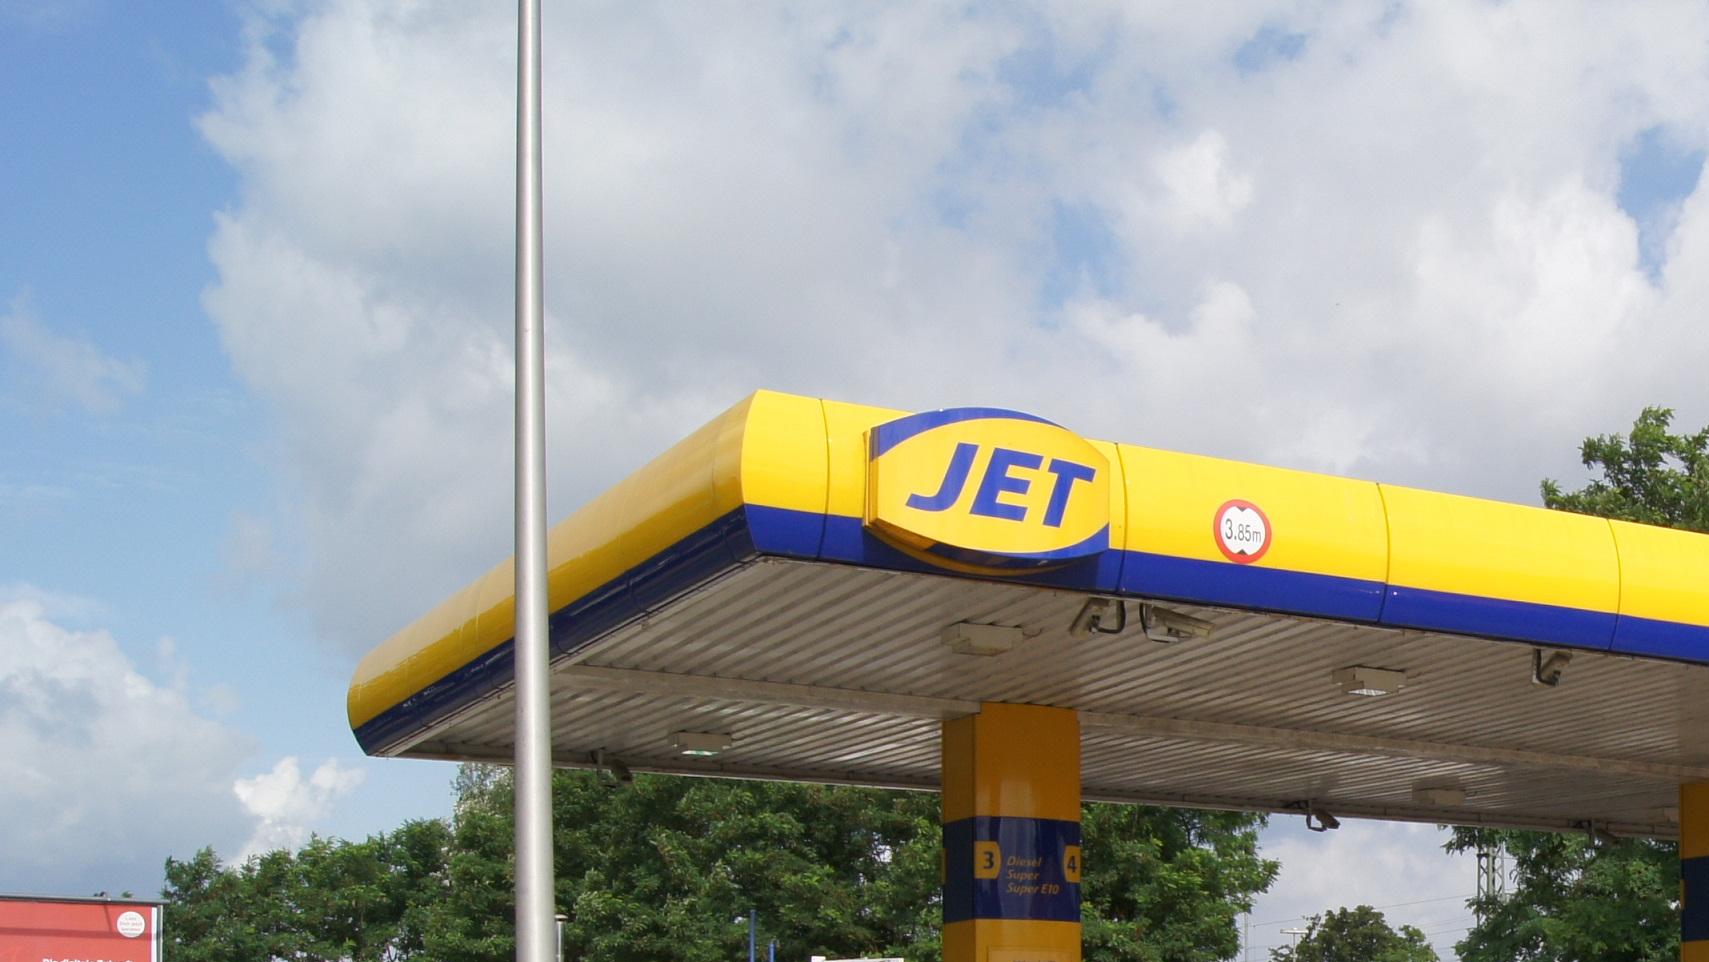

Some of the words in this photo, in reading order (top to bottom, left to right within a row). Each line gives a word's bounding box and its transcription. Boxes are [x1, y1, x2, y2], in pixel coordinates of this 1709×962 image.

[905, 442, 1096, 528] JET
[1225, 518, 1261, 543] 3.85m
[983, 851, 994, 869] 3
[1007, 856, 1042, 867] Diesel
[1067, 855, 1077, 873] 4
[1007, 869, 1039, 882] Super
[1007, 882, 1039, 896] Super
[1041, 883, 1060, 895] E10
